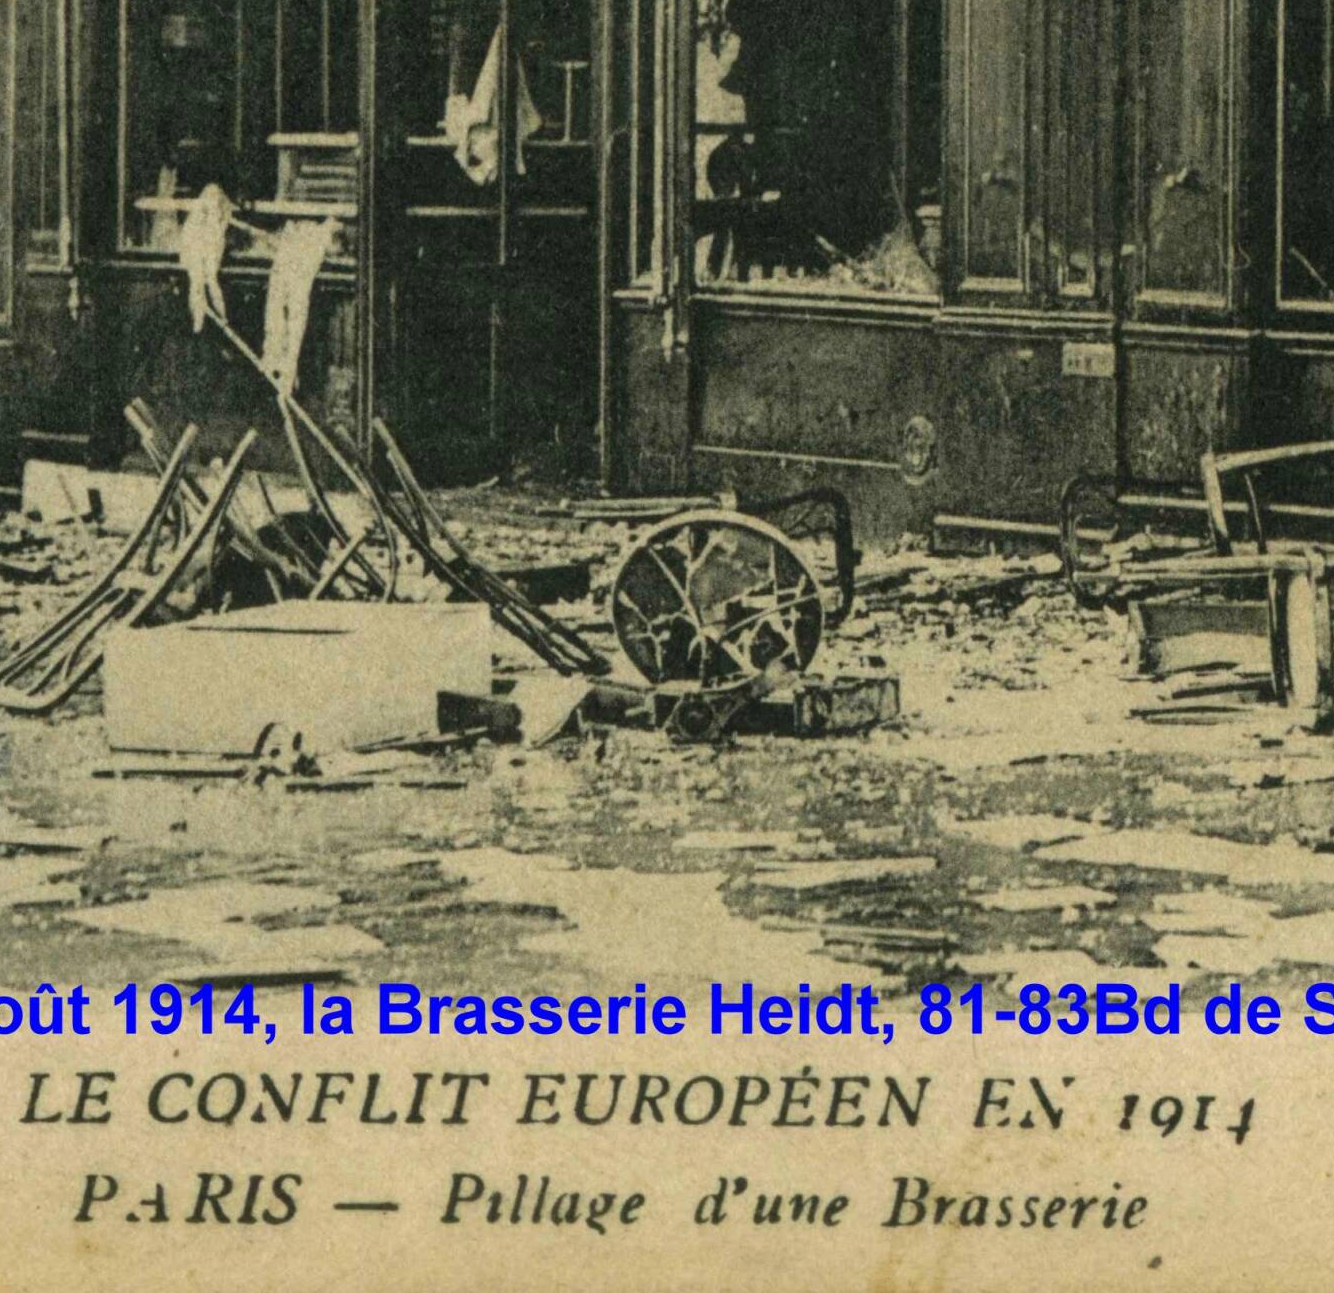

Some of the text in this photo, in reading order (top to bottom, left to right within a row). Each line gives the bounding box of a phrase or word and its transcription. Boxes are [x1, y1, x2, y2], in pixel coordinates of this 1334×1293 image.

[20, 1065, 1255, 1145] LE CONFLIT EUROPÉEN EN 1914
[74, 1172, 302, 1226] PARIS
[441, 1173, 645, 1235] Pillage
[694, 1176, 849, 1227] d'une
[881, 1176, 1148, 1229] Brasserie
